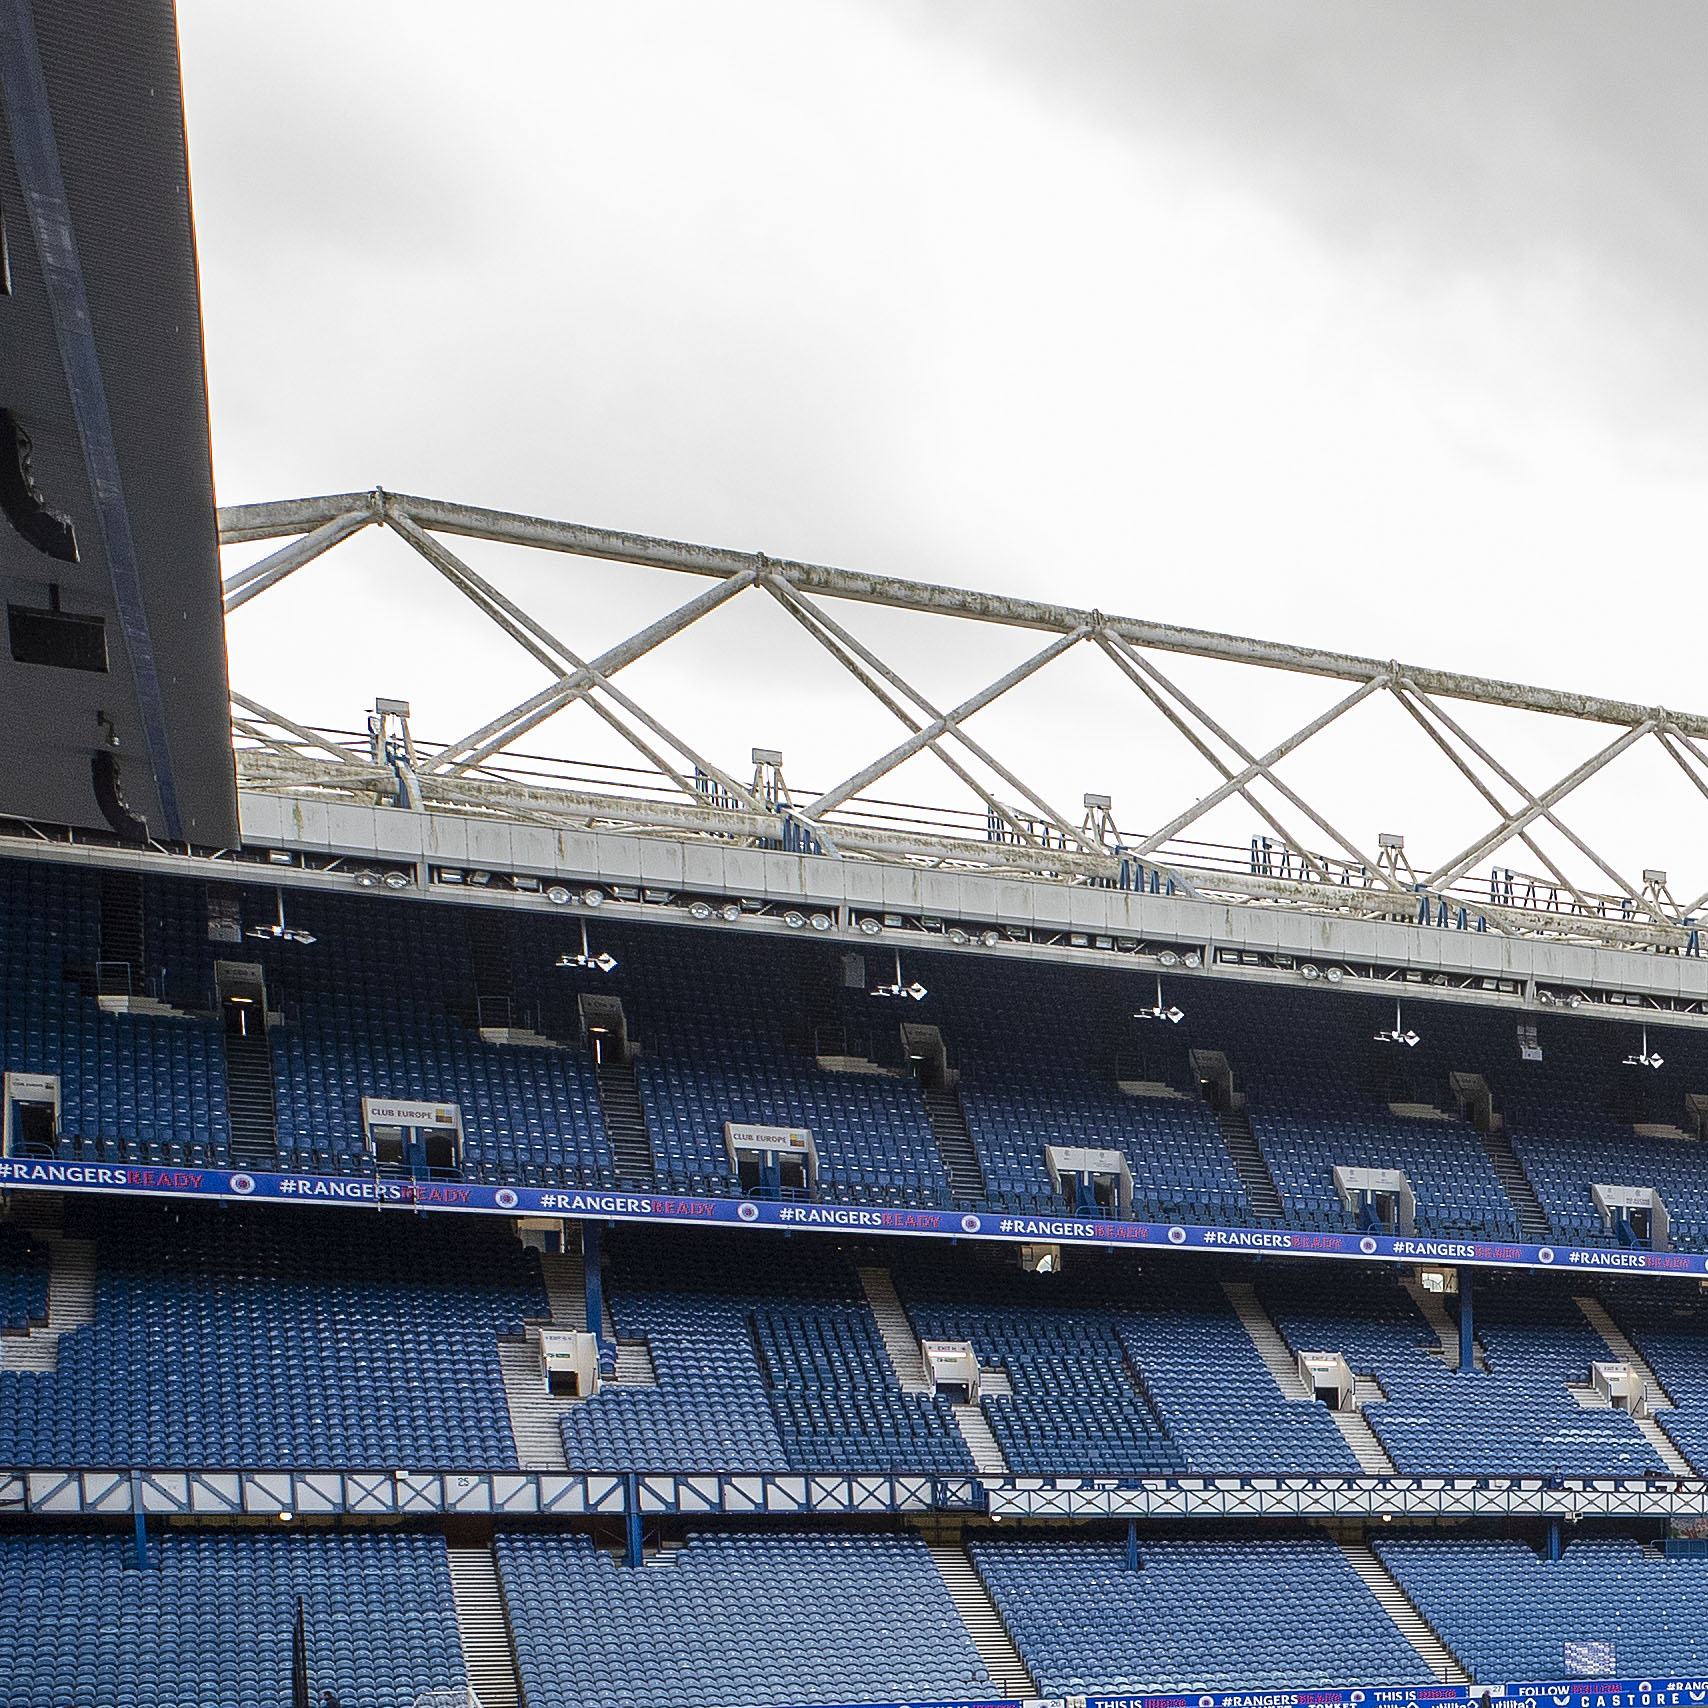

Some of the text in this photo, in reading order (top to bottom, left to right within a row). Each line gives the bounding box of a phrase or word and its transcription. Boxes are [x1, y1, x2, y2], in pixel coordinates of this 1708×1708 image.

[371, 1108, 432, 1120] CLUB EUROPE
[756, 1135, 787, 1144] EUROPE
[0, 1163, 204, 1188] #RANGERSREADY
[540, 1194, 715, 1217] #RANGERSREADY
[779, 1207, 941, 1228] #RANGERSREADY
[1000, 1219, 1150, 1240] #RANGERSREADY
[1374, 1690, 1404, 1702] THIS
[1407, 1690, 1416, 1700] IS
[1519, 1685, 1570, 1697] FOLLOW
[1581, 1691, 1680, 1707] CASTORE
